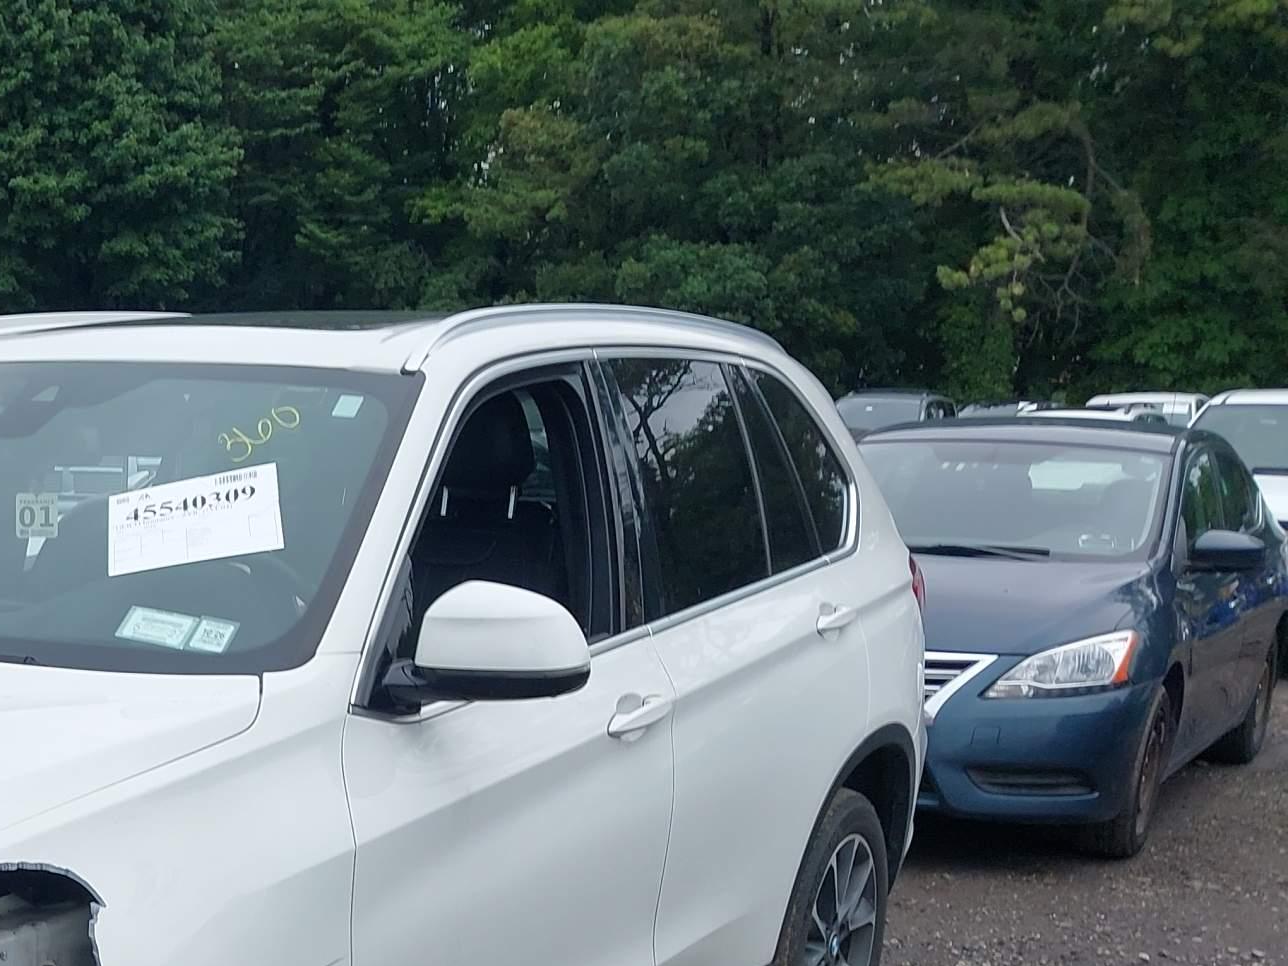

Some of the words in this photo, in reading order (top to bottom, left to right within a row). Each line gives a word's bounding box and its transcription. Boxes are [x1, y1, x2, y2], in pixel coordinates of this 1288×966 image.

[217, 405, 300, 463] 360
[18, 505, 55, 528] 01
[125, 484, 257, 522] 45540309
